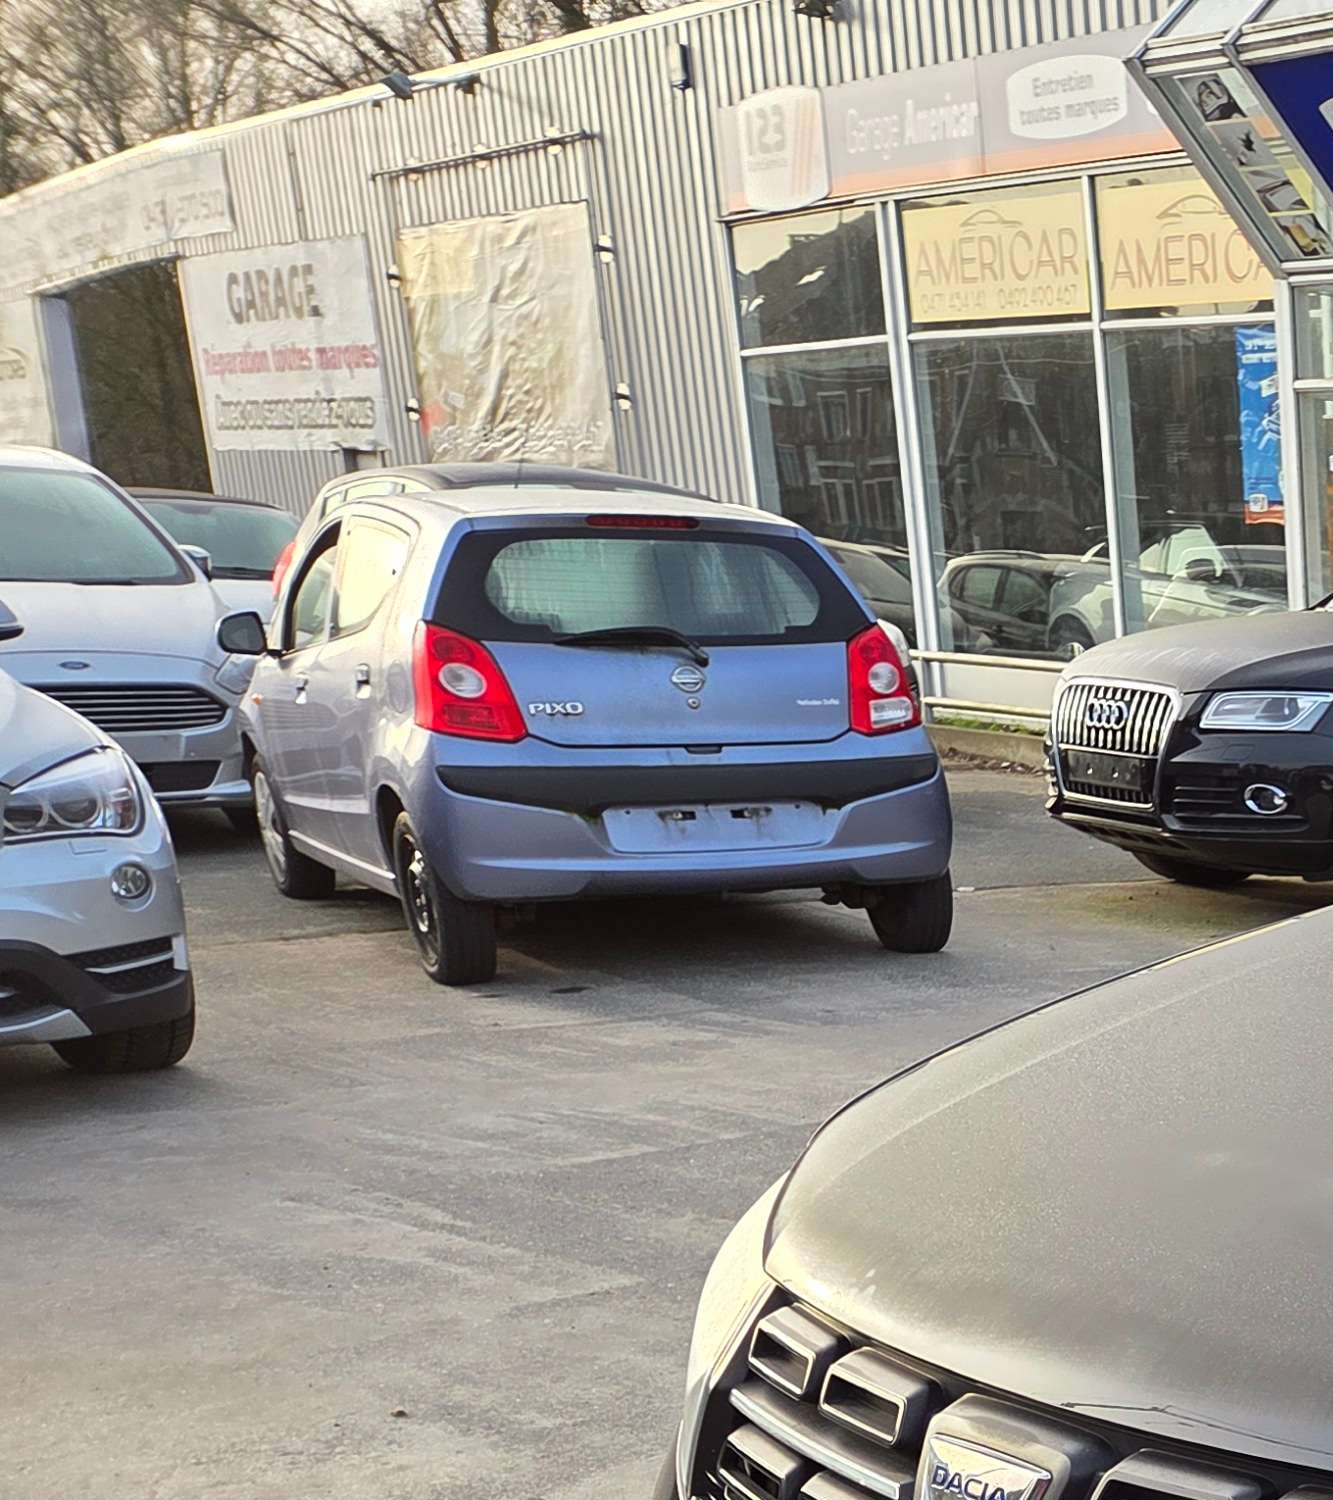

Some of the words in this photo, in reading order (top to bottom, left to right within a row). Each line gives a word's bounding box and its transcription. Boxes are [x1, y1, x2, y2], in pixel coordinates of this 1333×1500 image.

[1031, 70, 1094, 97] Entretien
[914, 227, 1080, 287] AMERICAR
[226, 263, 323, 325] GARAGE
[528, 702, 585, 716] PIXO
